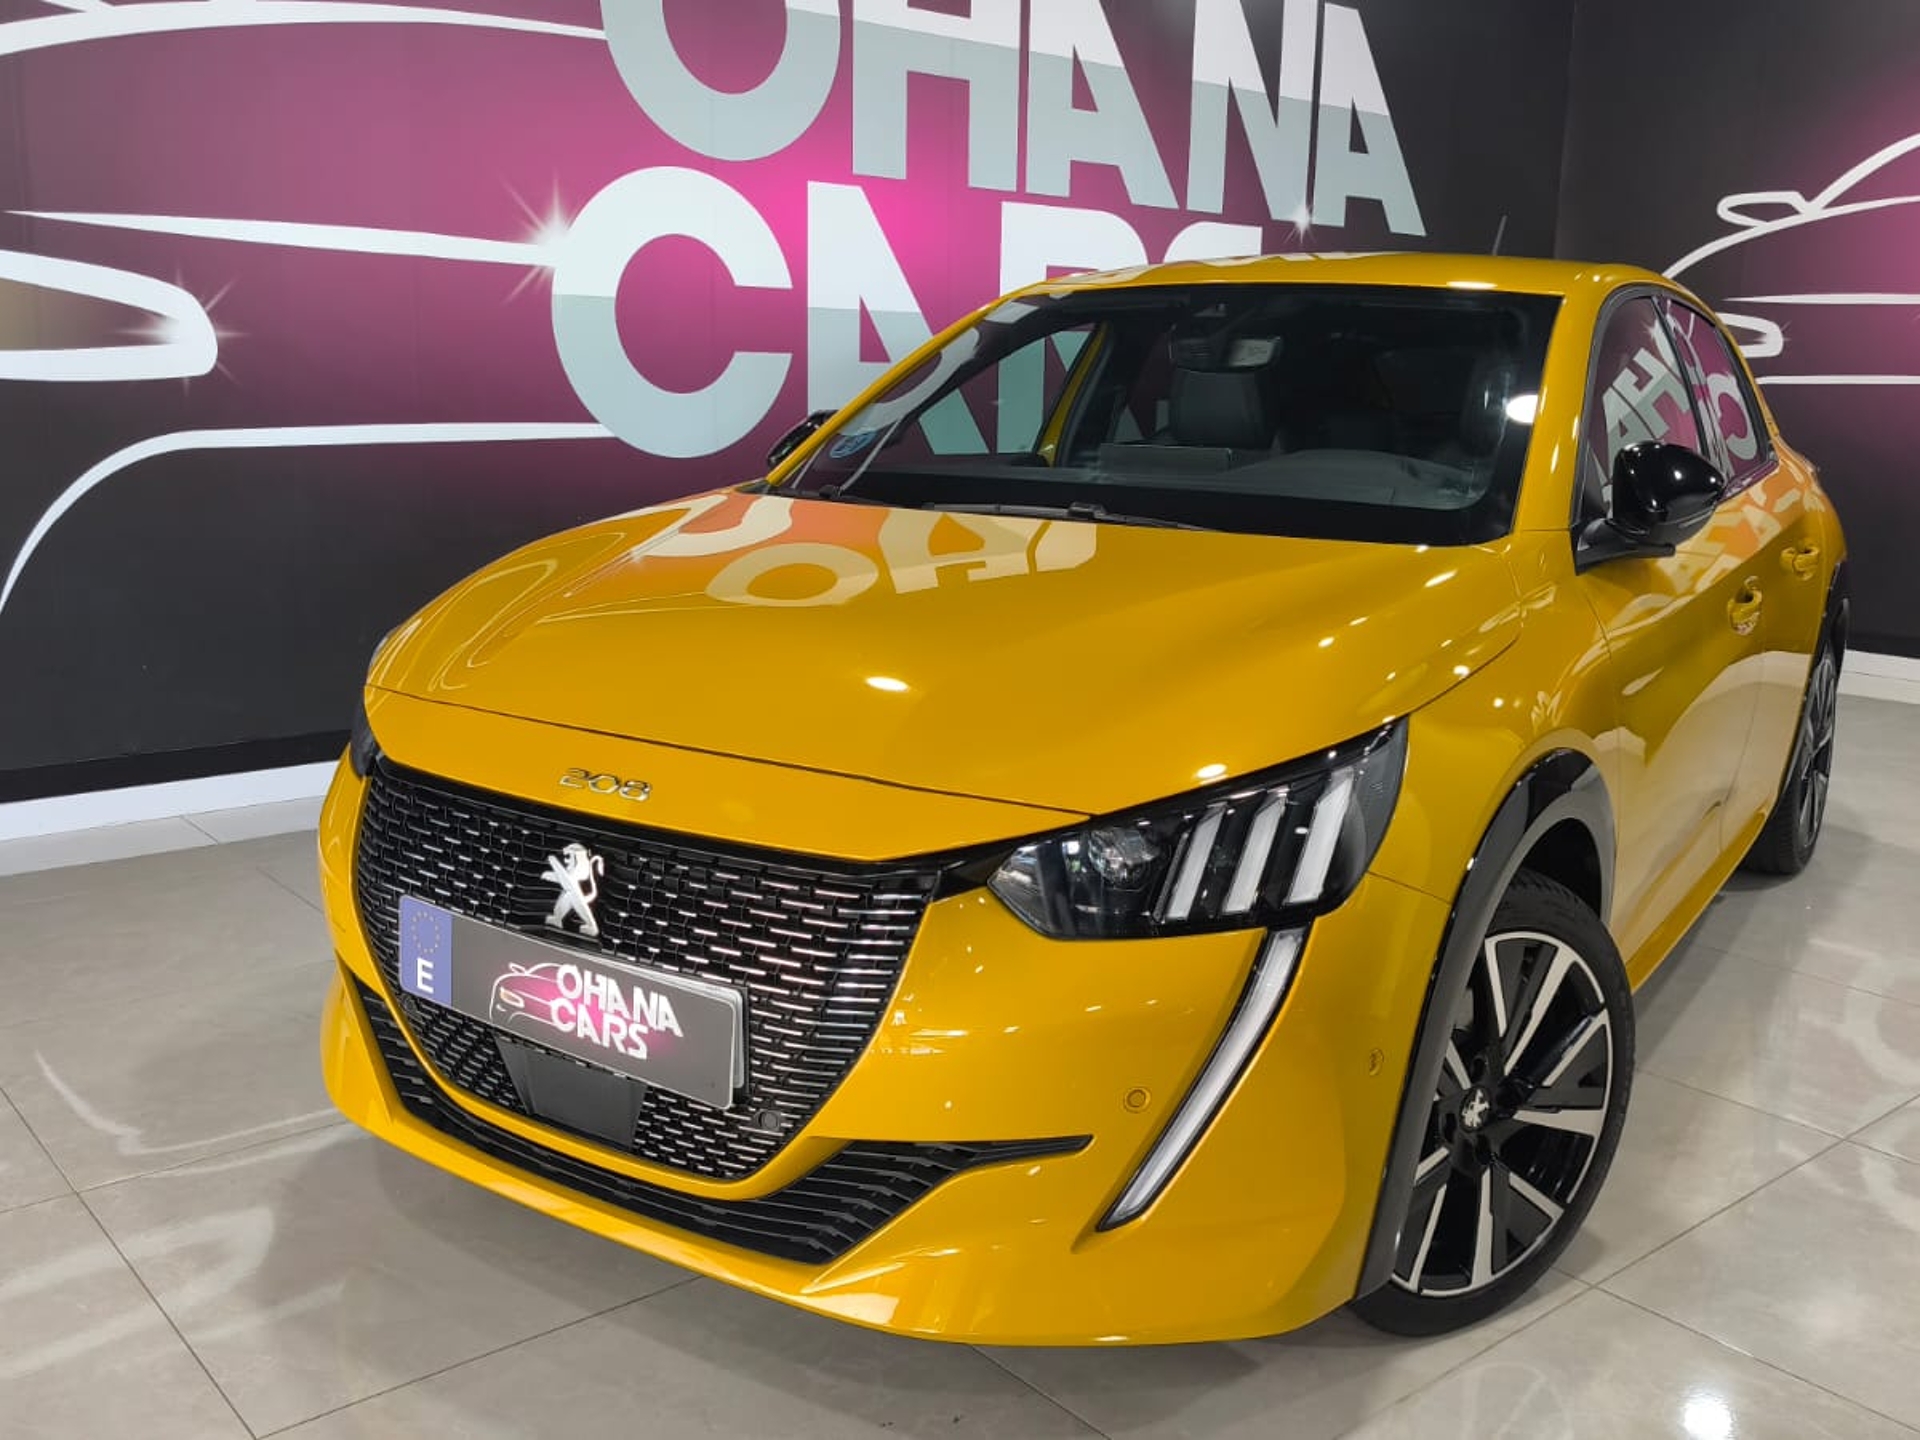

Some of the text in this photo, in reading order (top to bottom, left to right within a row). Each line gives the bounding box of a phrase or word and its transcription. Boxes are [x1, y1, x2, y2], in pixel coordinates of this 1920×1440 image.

[601, 0, 1426, 236] OHANA
[551, 166, 1263, 458] CAR
[560, 767, 651, 801] 208
[416, 957, 434, 994] E
[557, 964, 684, 1038] OHANA
[551, 998, 649, 1060] CARS
